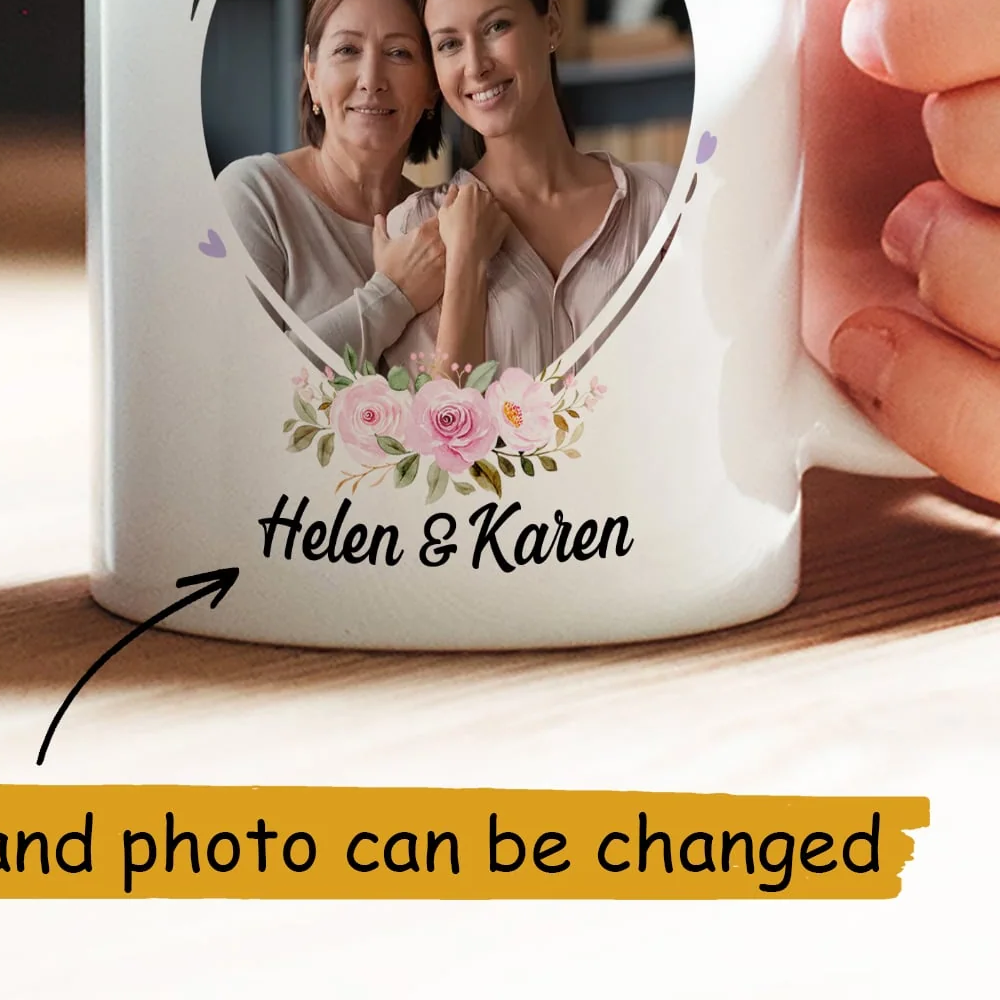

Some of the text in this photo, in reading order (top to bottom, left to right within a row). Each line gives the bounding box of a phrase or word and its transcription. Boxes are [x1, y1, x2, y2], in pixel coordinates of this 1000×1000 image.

[258, 493, 634, 573] Helen & Karen
